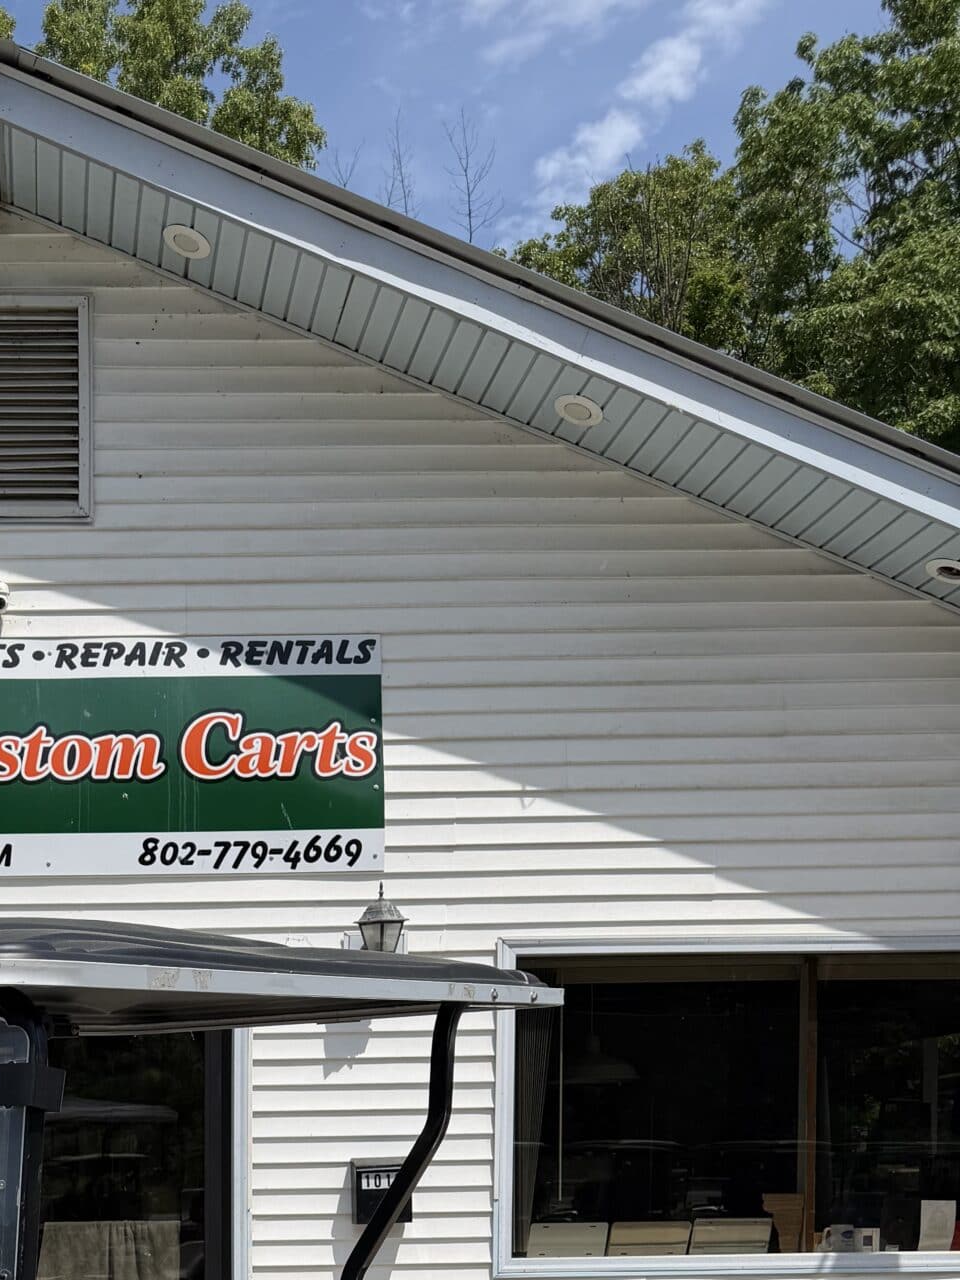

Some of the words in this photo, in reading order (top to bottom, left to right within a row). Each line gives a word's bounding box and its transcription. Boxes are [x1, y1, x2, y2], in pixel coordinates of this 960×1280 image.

[54, 641, 188, 670] REPAIR
[219, 639, 377, 667] RENTALS
[180, 711, 378, 780] Carts
[138, 835, 363, 870] 802-779-4669
